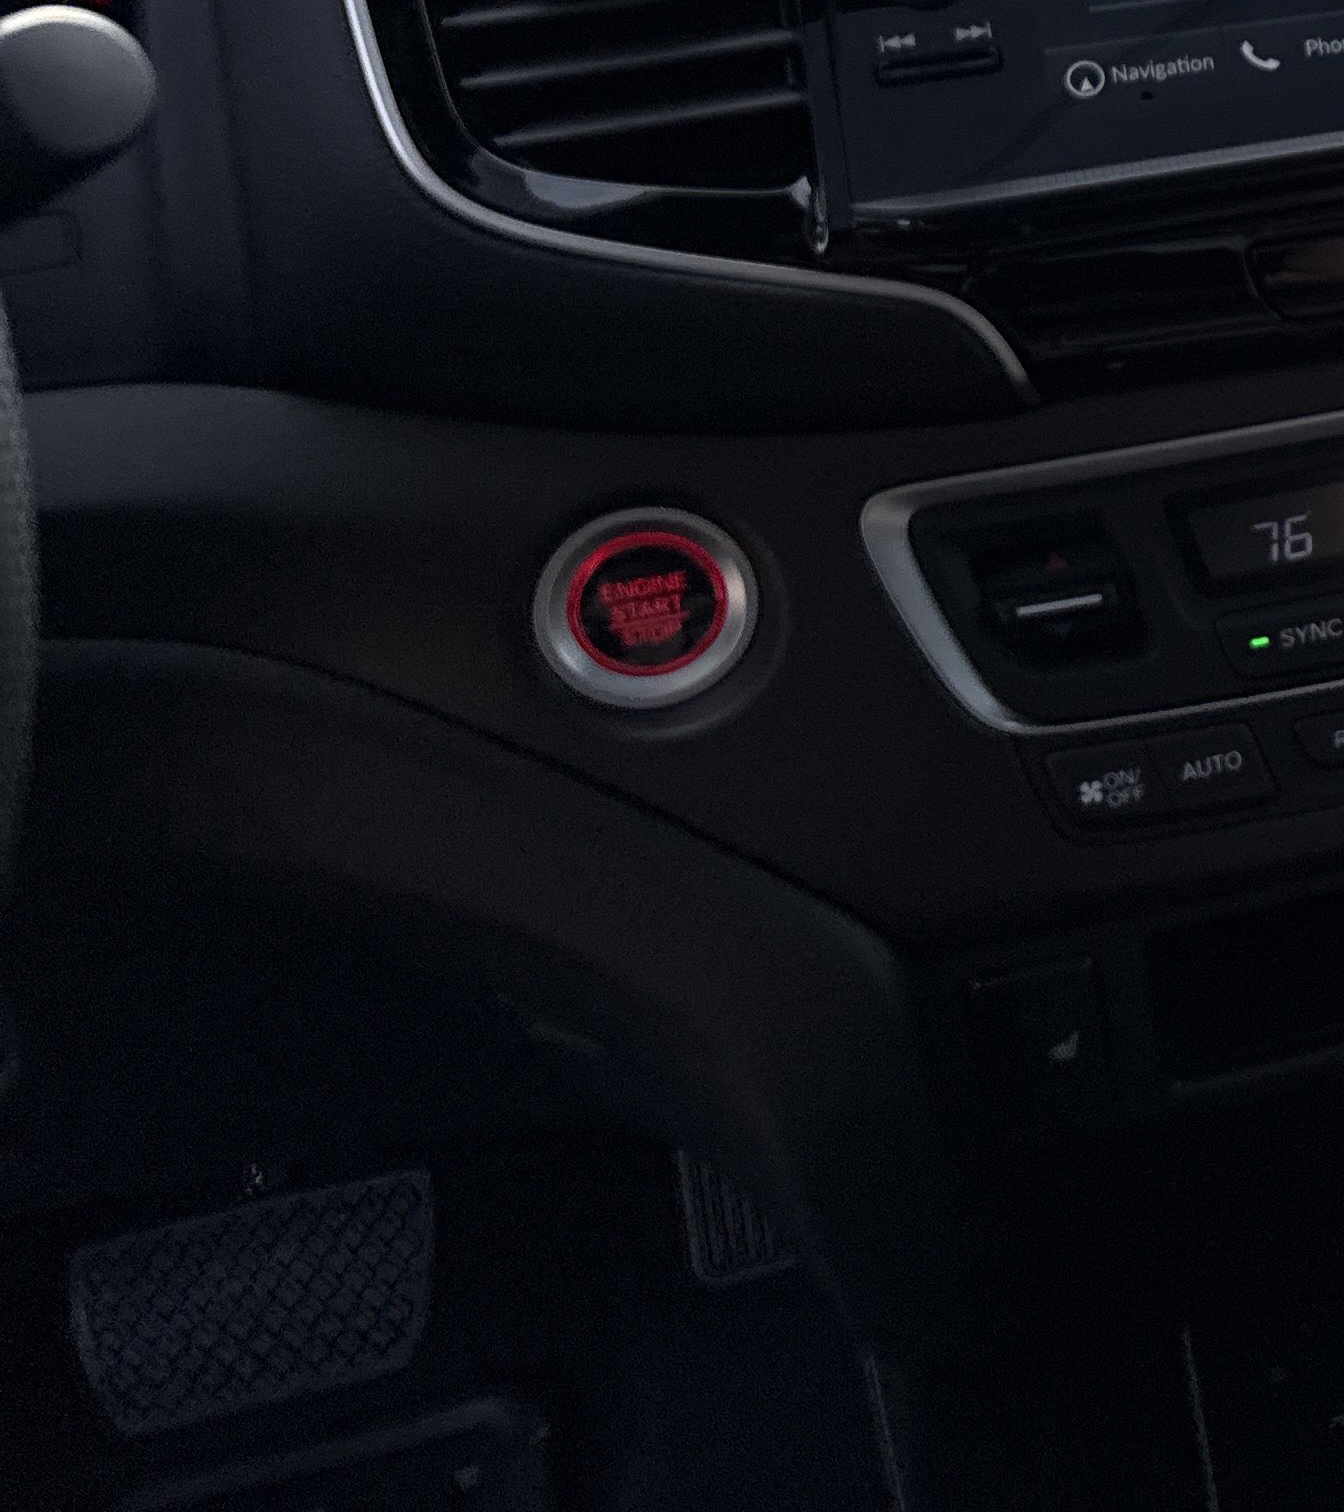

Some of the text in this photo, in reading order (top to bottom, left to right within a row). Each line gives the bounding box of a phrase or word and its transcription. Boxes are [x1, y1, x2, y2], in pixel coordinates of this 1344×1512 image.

[1111, 51, 1216, 85] Navigation
[1251, 513, 1314, 564] 76
[1278, 616, 1344, 651] SYNC
[1180, 748, 1244, 783] AUTO
[1106, 784, 1145, 809] OFF
